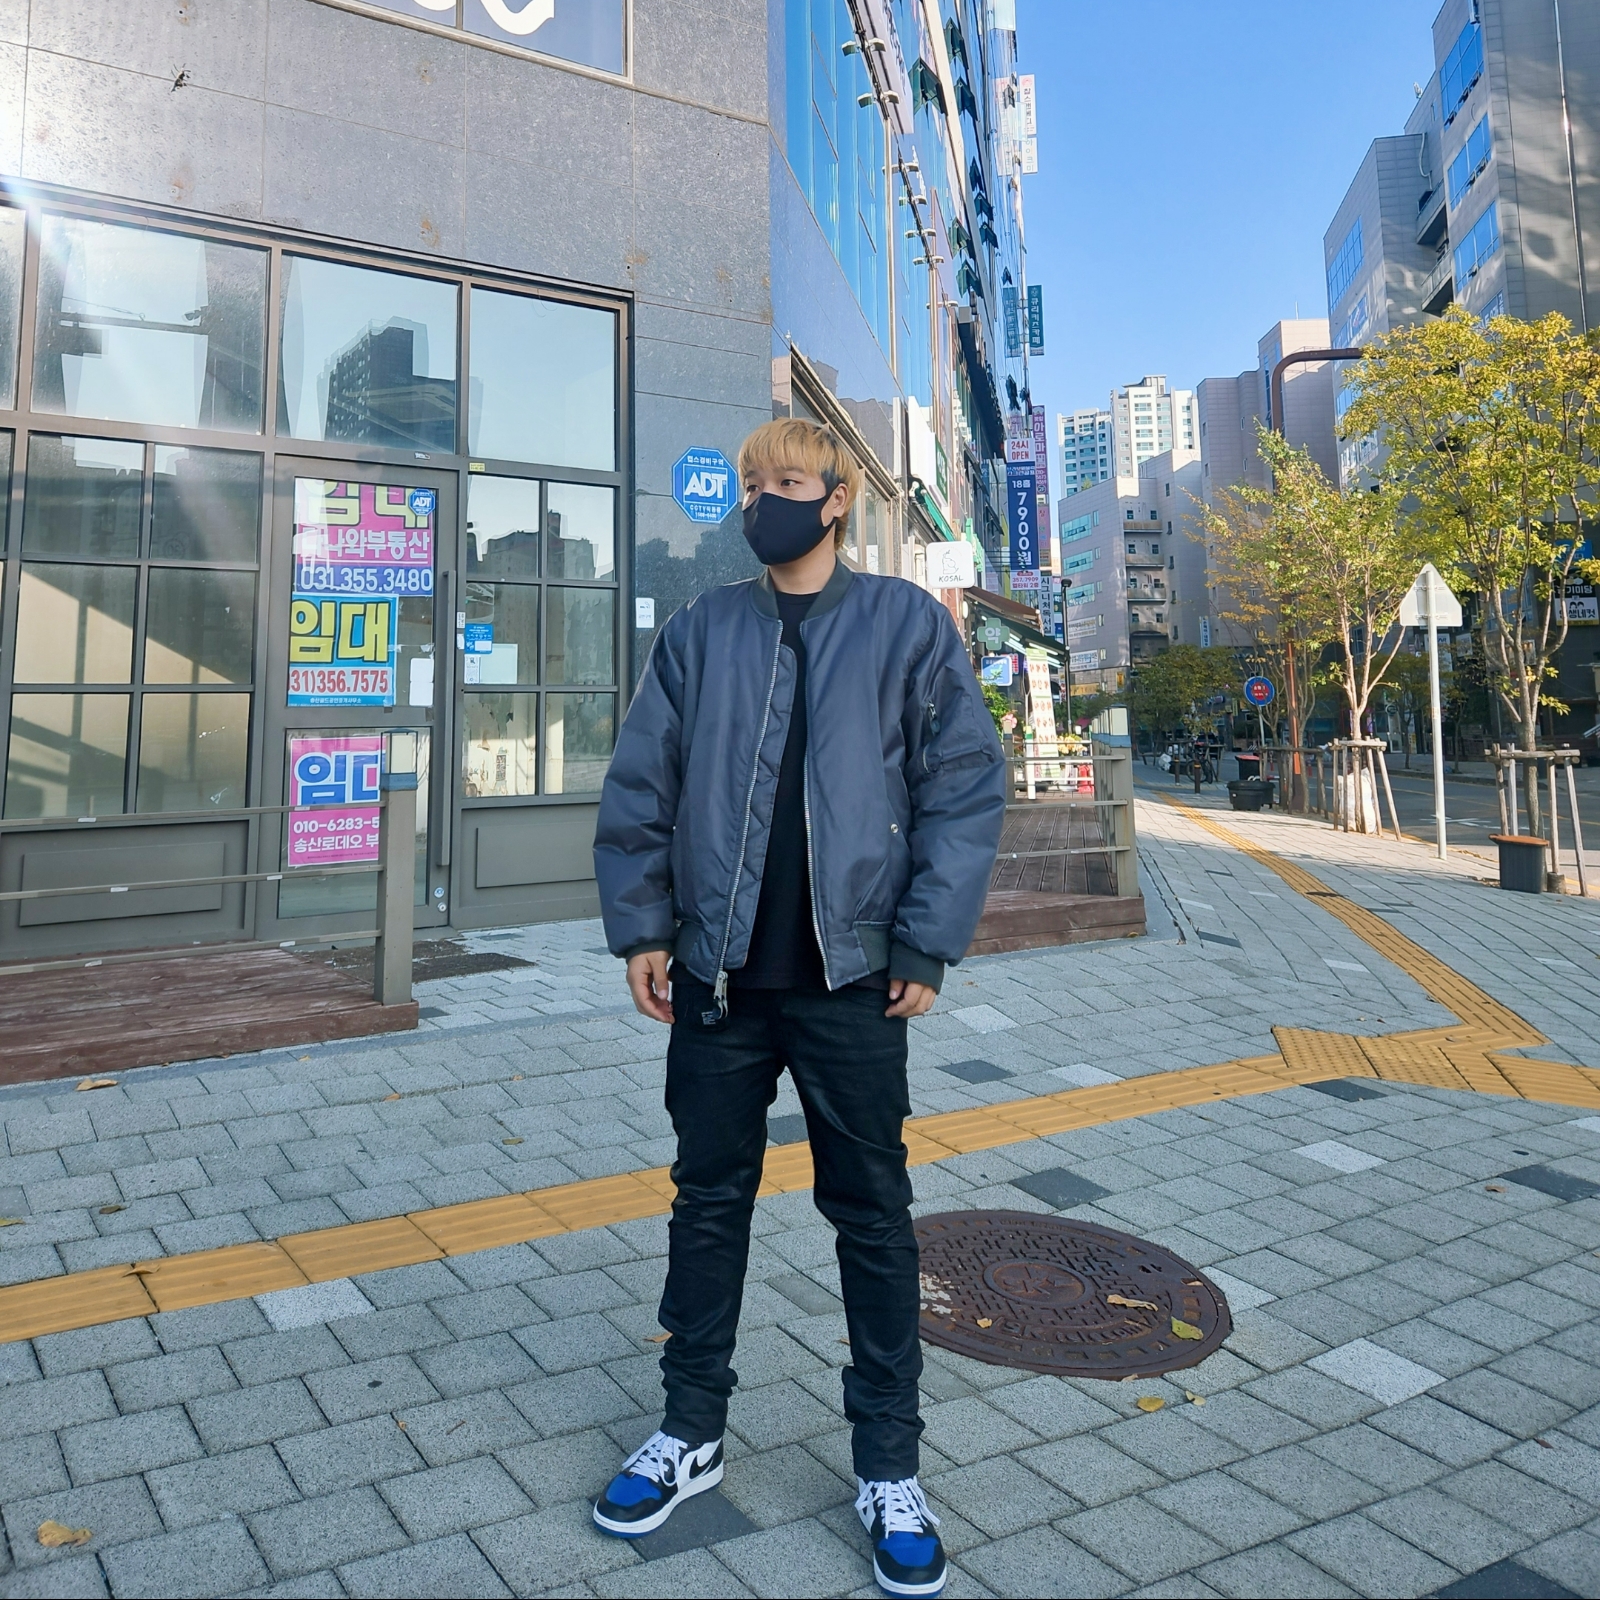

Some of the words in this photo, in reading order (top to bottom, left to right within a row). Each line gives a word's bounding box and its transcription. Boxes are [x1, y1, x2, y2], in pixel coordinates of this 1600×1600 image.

[1011, 441, 1029, 450] 24시
[1011, 451, 1029, 460] OPEN
[684, 471, 727, 498] ADT
[413, 496, 432, 507] ADT
[300, 566, 433, 592] 031.355.3480
[938, 575, 964, 583] KOSAL
[290, 599, 391, 664] 임대
[985, 627, 1001, 644] 약
[287, 669, 388, 694] 31)356.7575
[293, 834, 363, 854] 송산로데오
